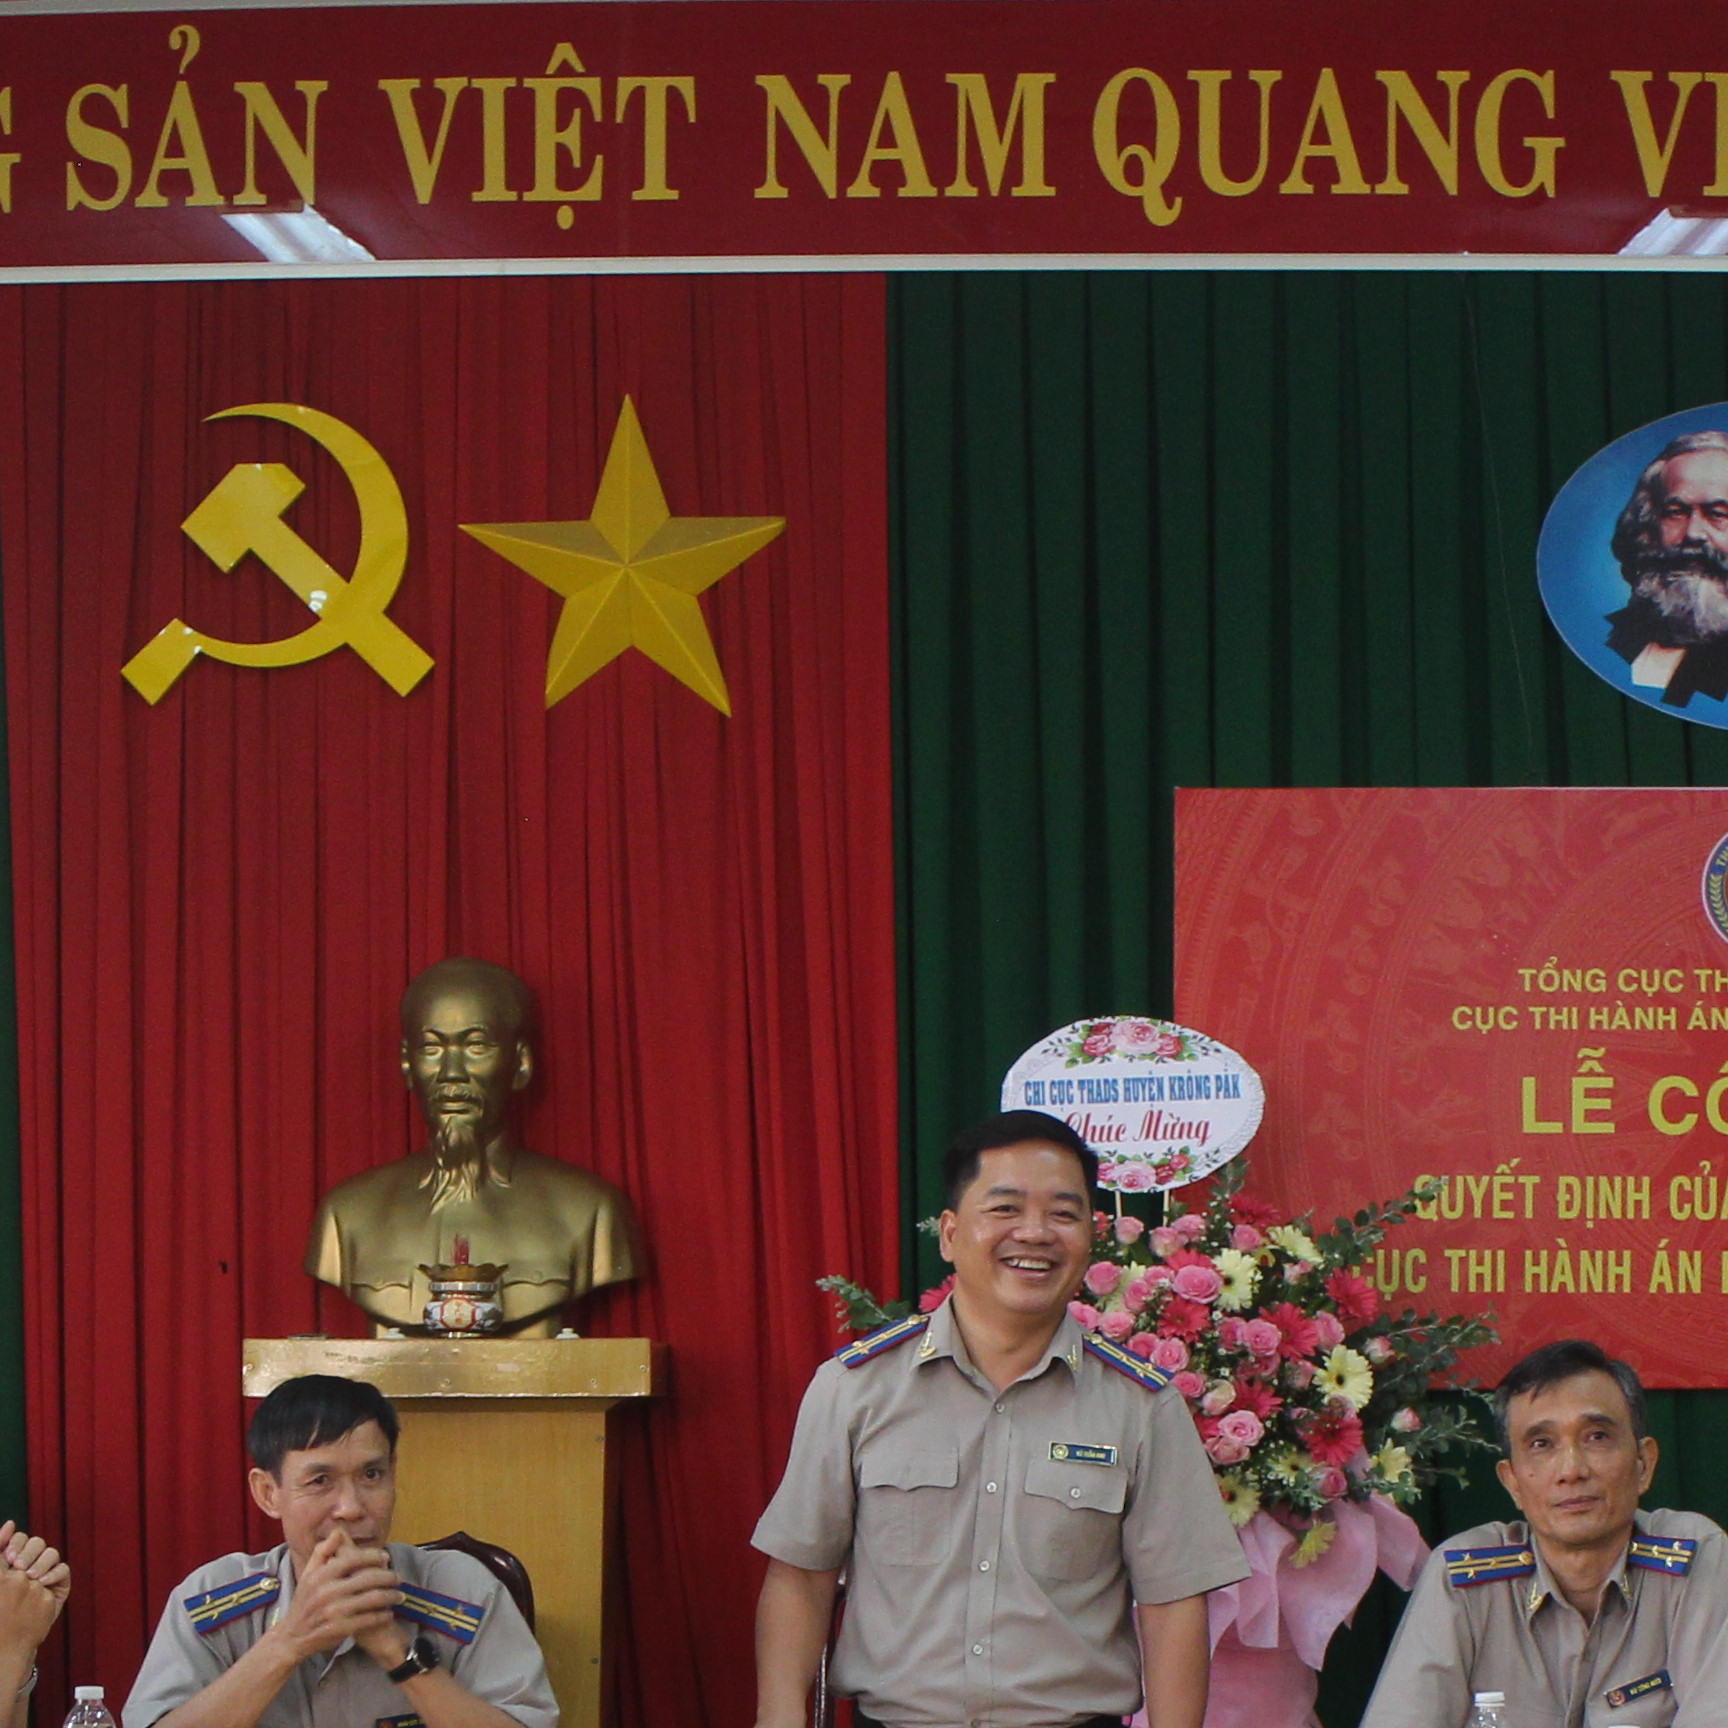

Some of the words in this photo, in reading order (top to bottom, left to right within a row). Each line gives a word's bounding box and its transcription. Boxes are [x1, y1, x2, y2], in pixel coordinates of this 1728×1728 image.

[68, 26, 329, 209] SẢN
[380, 44, 696, 230] VIỆT
[756, 72, 1057, 199] NAM
[1093, 68, 1566, 226] QUANG
[1517, 956, 1610, 994] TỔNG
[1617, 968, 1687, 998] CỤC
[1451, 1005, 1522, 1035] CỤC
[1528, 1006, 1582, 1032] THI
[1588, 1001, 1679, 1032] HÀNH
[1024, 1080, 1046, 1106] CHI
[1077, 1078, 1120, 1104] THADS
[1123, 1070, 1165, 1108] HUYỆN
[1521, 1047, 1617, 1136] LỄ
[1132, 1109, 1210, 1147] Mừng
[1413, 1158, 1542, 1223] QUYẾT
[1556, 1175, 1654, 1230] ĐỊNH
[1354, 1248, 1428, 1302] ỤC
[1443, 1249, 1508, 1294] THI
[1523, 1238, 1634, 1295] HÀNH
[1648, 1238, 1705, 1295] ÁN
